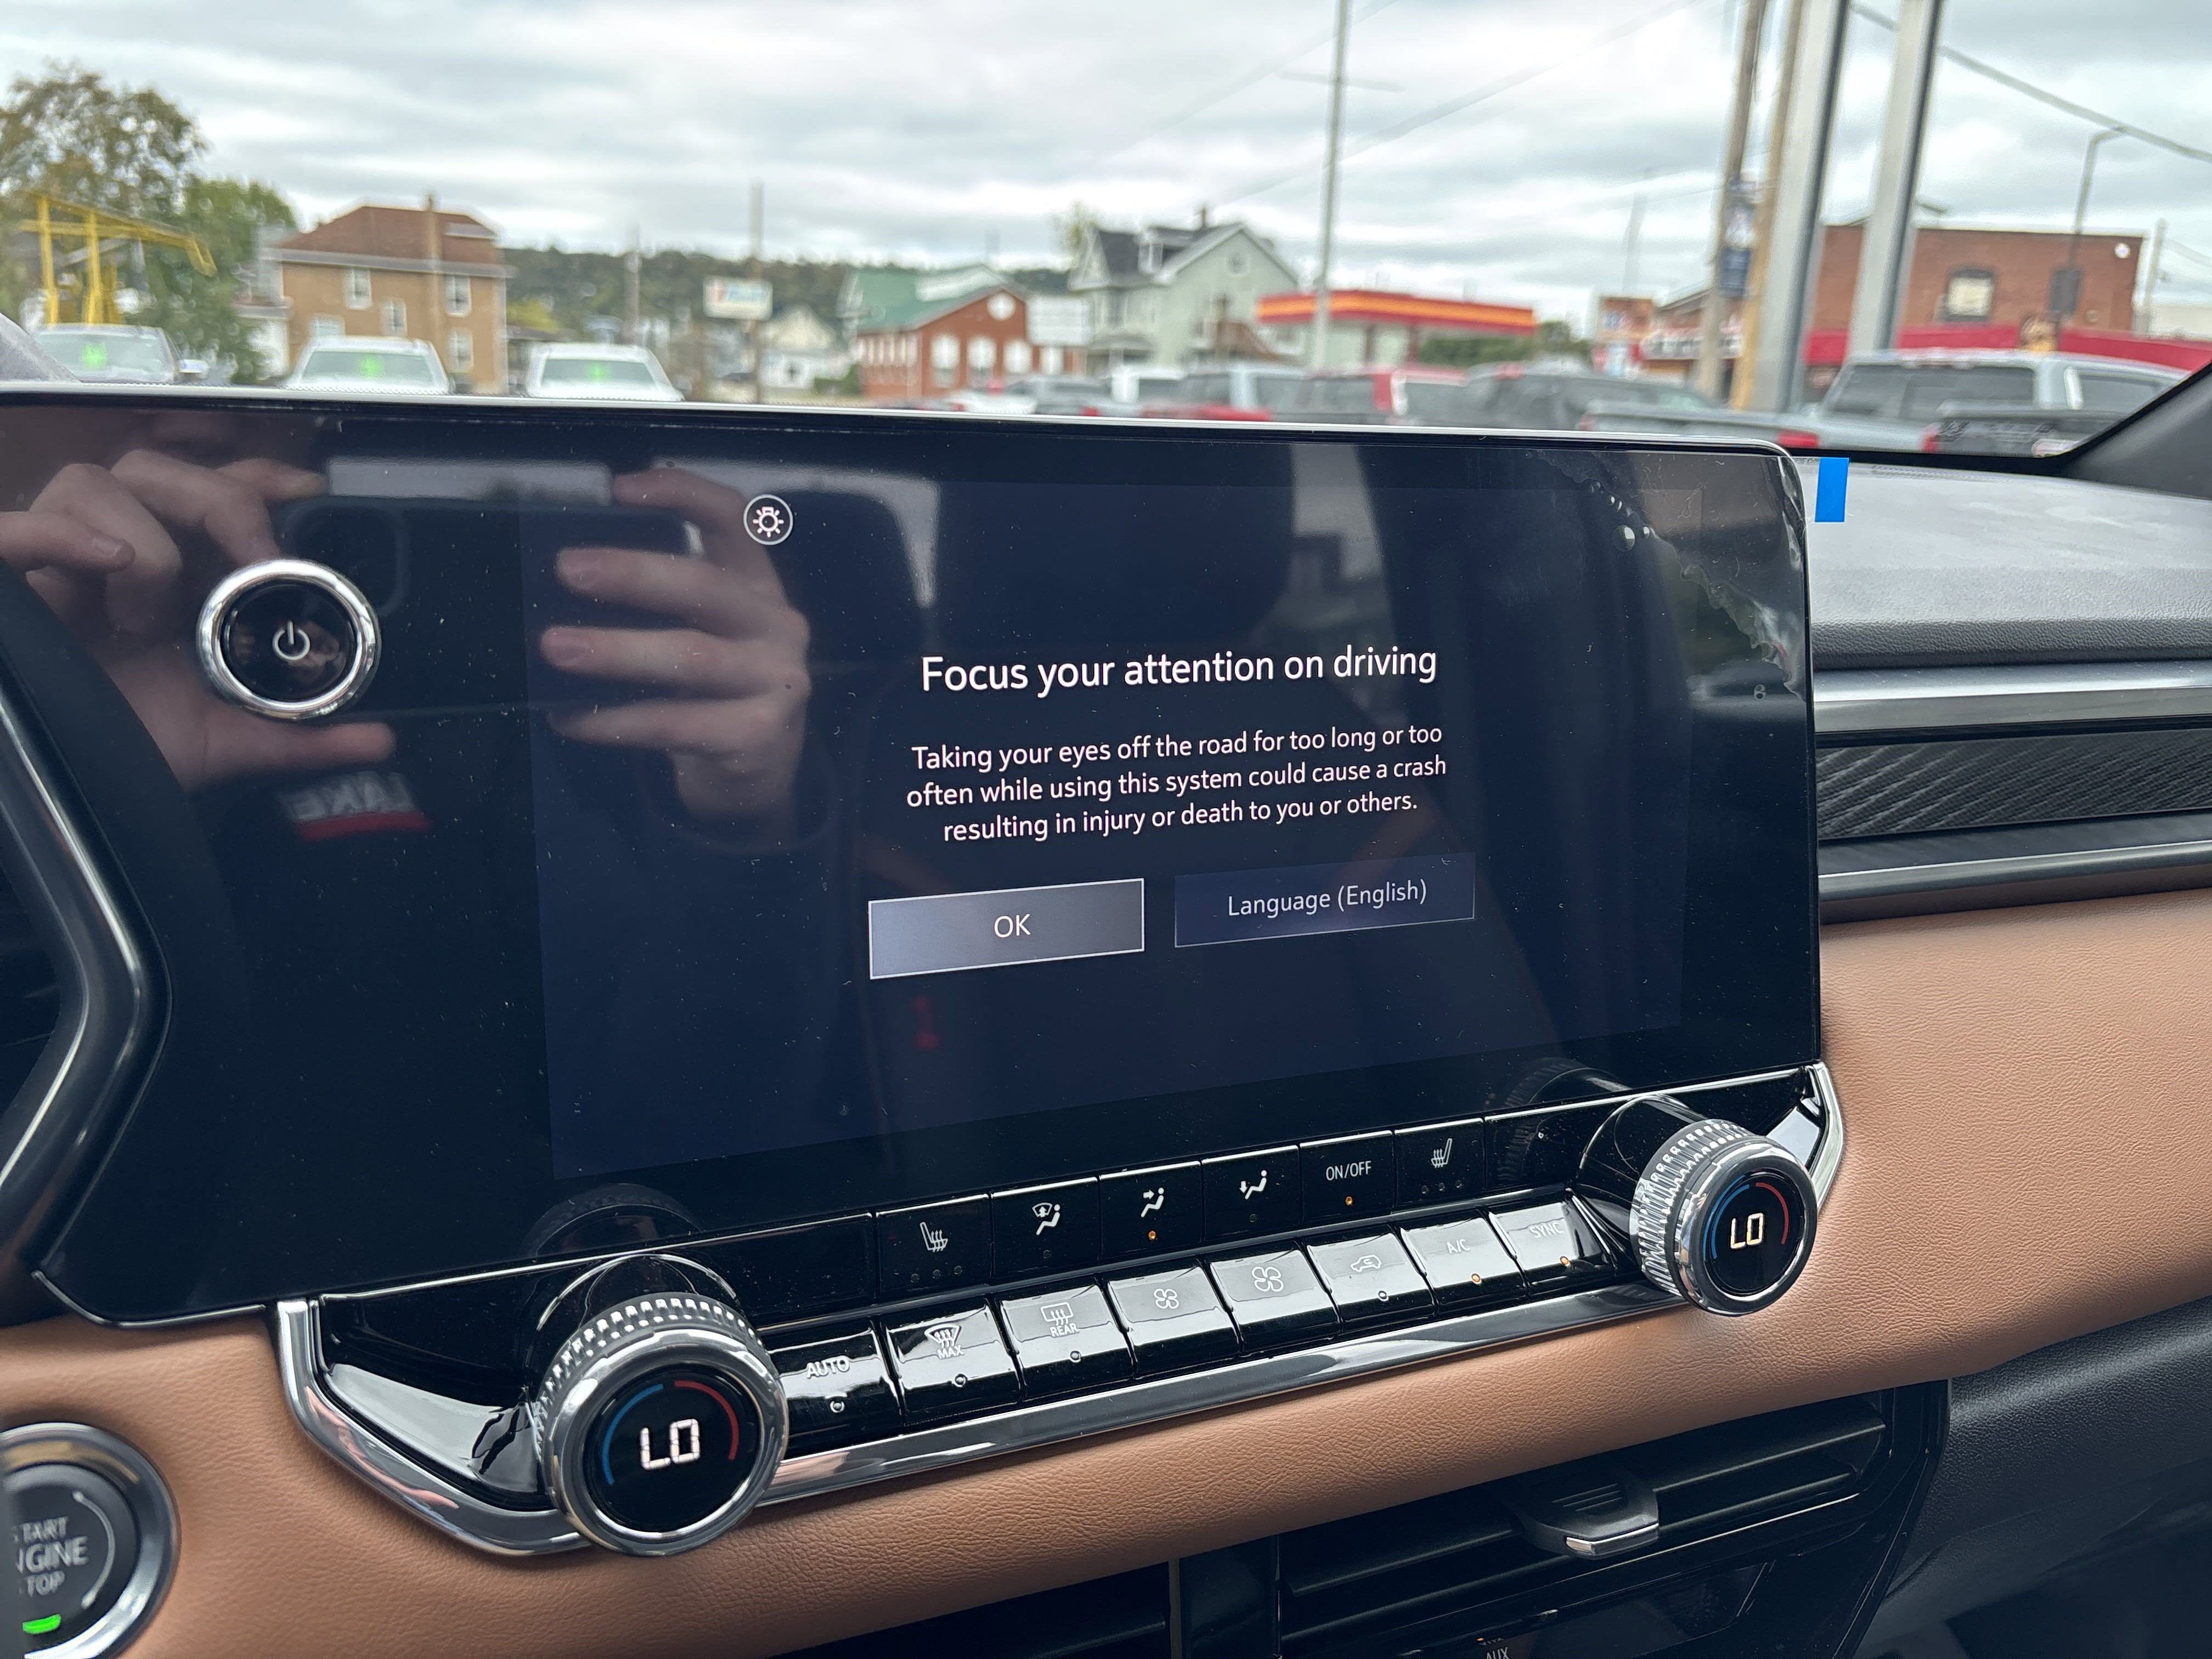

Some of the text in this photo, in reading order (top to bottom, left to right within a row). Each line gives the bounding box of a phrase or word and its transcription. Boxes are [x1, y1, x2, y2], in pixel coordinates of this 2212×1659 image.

[921, 643, 1437, 699] Focus your attention on driving
[911, 724, 1443, 774] Taking your eyes off the road for too long or too
[906, 753, 1447, 808] often while using this system could cause a crash
[943, 789, 1419, 843] resulting in injury or death to you or others.
[1228, 878, 1427, 920] Language (English)
[994, 913, 1031, 938] OK
[1325, 1160, 1372, 1181] ON/OFF
[1529, 1221, 1564, 1239] SYNC
[1729, 1212, 1765, 1250] LO
[1446, 1238, 1471, 1255] A/C
[1049, 1322, 1080, 1338] REAR
[937, 1344, 964, 1360] MAX
[806, 1357, 850, 1379] AUTO
[639, 1418, 701, 1470] LO
[14, 1516, 69, 1544] TART
[20, 1570, 65, 1598] TOP
